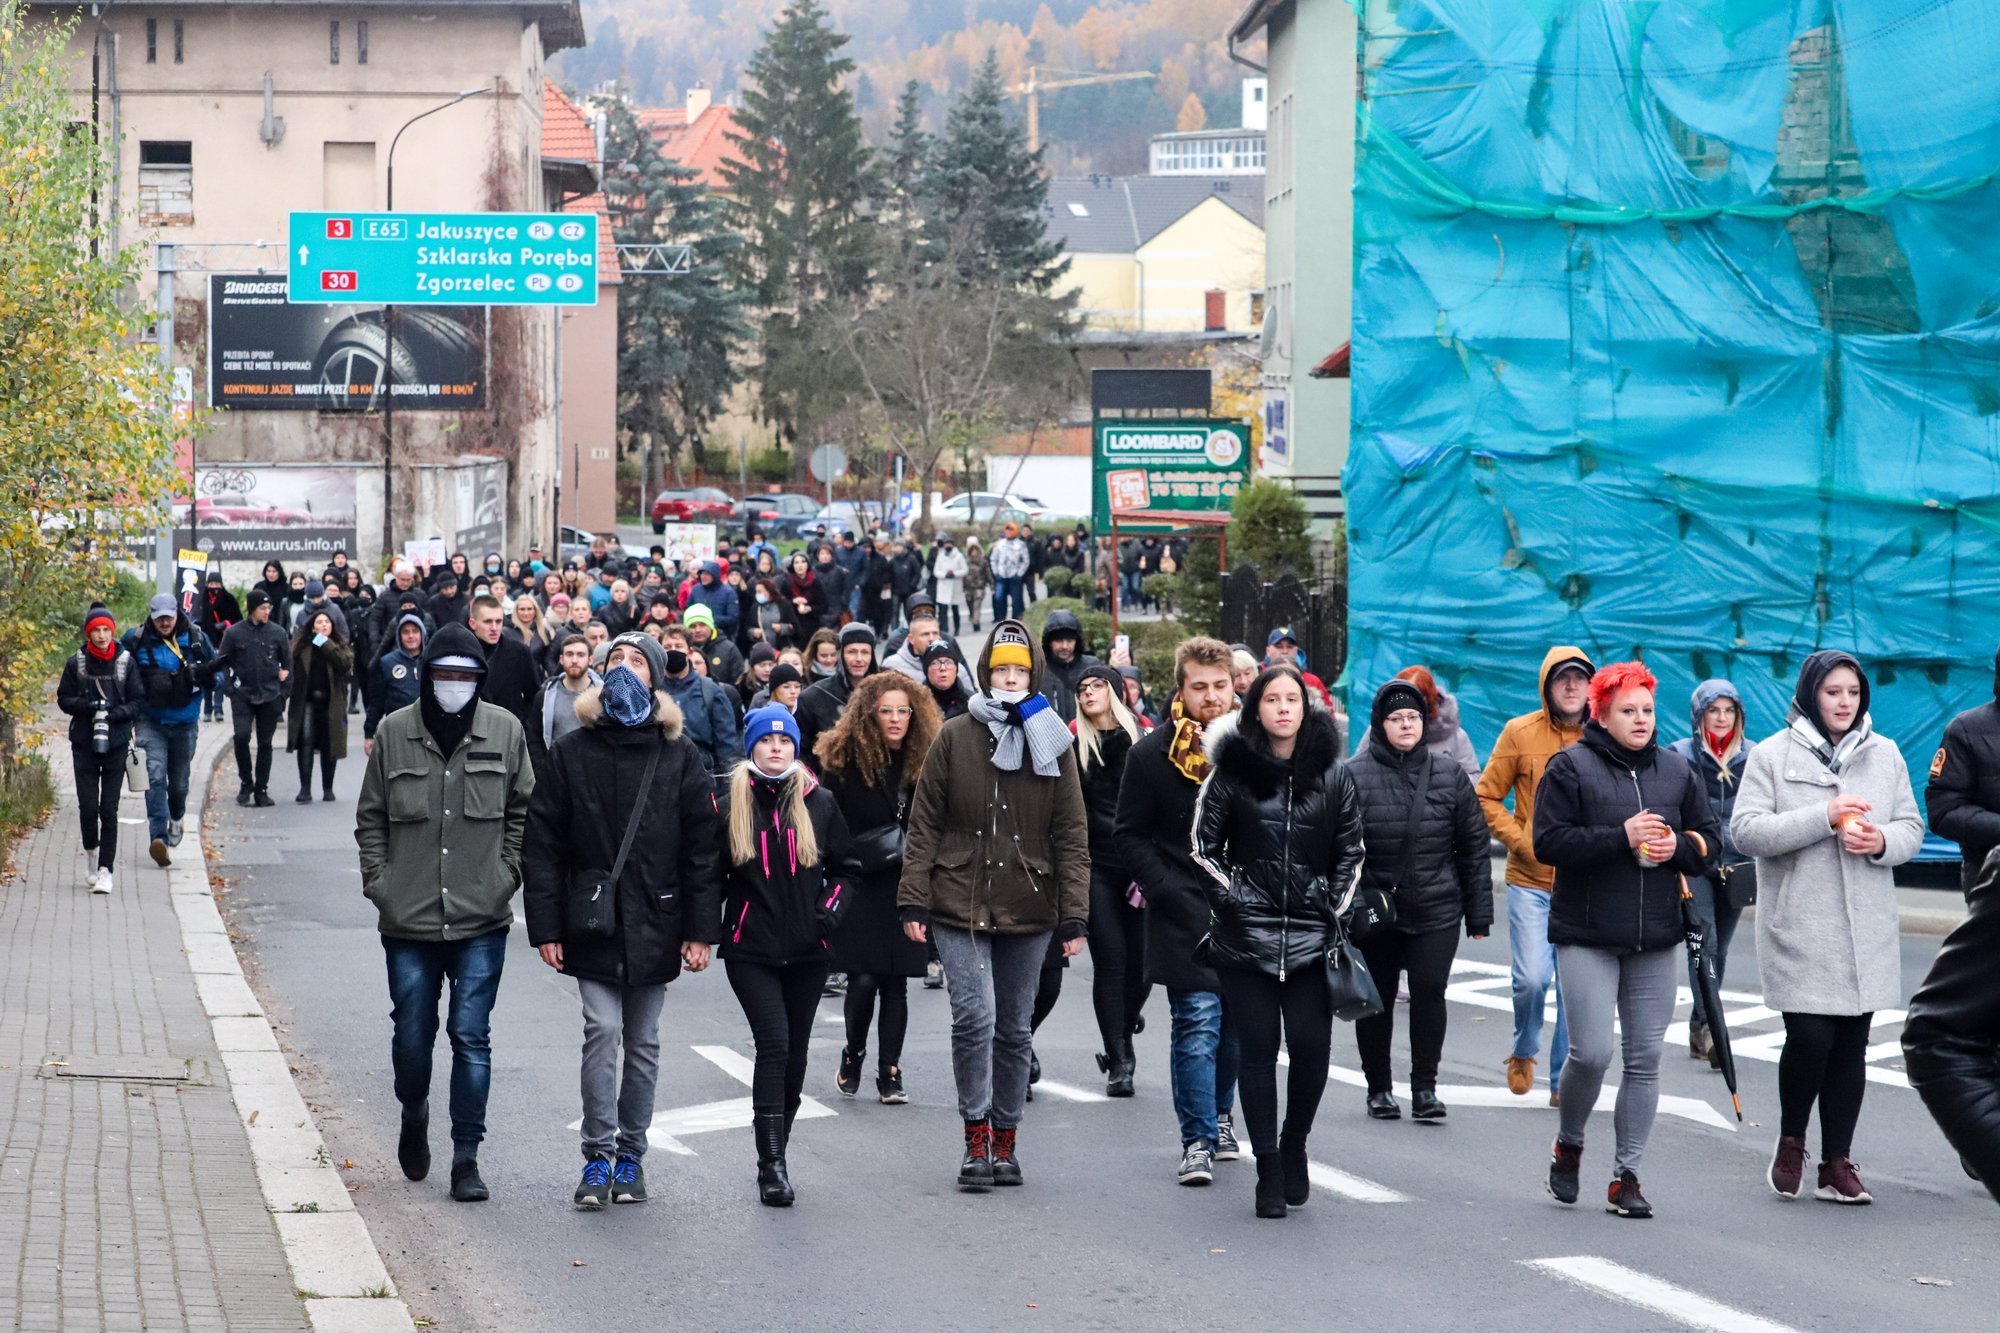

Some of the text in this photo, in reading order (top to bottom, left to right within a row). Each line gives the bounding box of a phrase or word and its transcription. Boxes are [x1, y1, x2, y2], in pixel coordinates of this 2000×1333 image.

[333, 221, 345, 236] 3
[415, 221, 518, 243] Jakuszyce
[533, 225, 548, 237] PL
[563, 225, 581, 237] CZ
[416, 247, 593, 270] Szklarska Poręba
[224, 281, 288, 294] BRIDGEST
[328, 273, 350, 289] 30
[416, 272, 516, 296] Zgorzelec
[531, 276, 546, 288] PL
[565, 277, 575, 289] D
[295, 384, 322, 395] NAWET
[380, 383, 428, 397] PĘDKOŚCIĄ
[429, 384, 440, 395] DO
[1110, 434, 1204, 450] LOOMBARD
[182, 551, 205, 562] STOP
